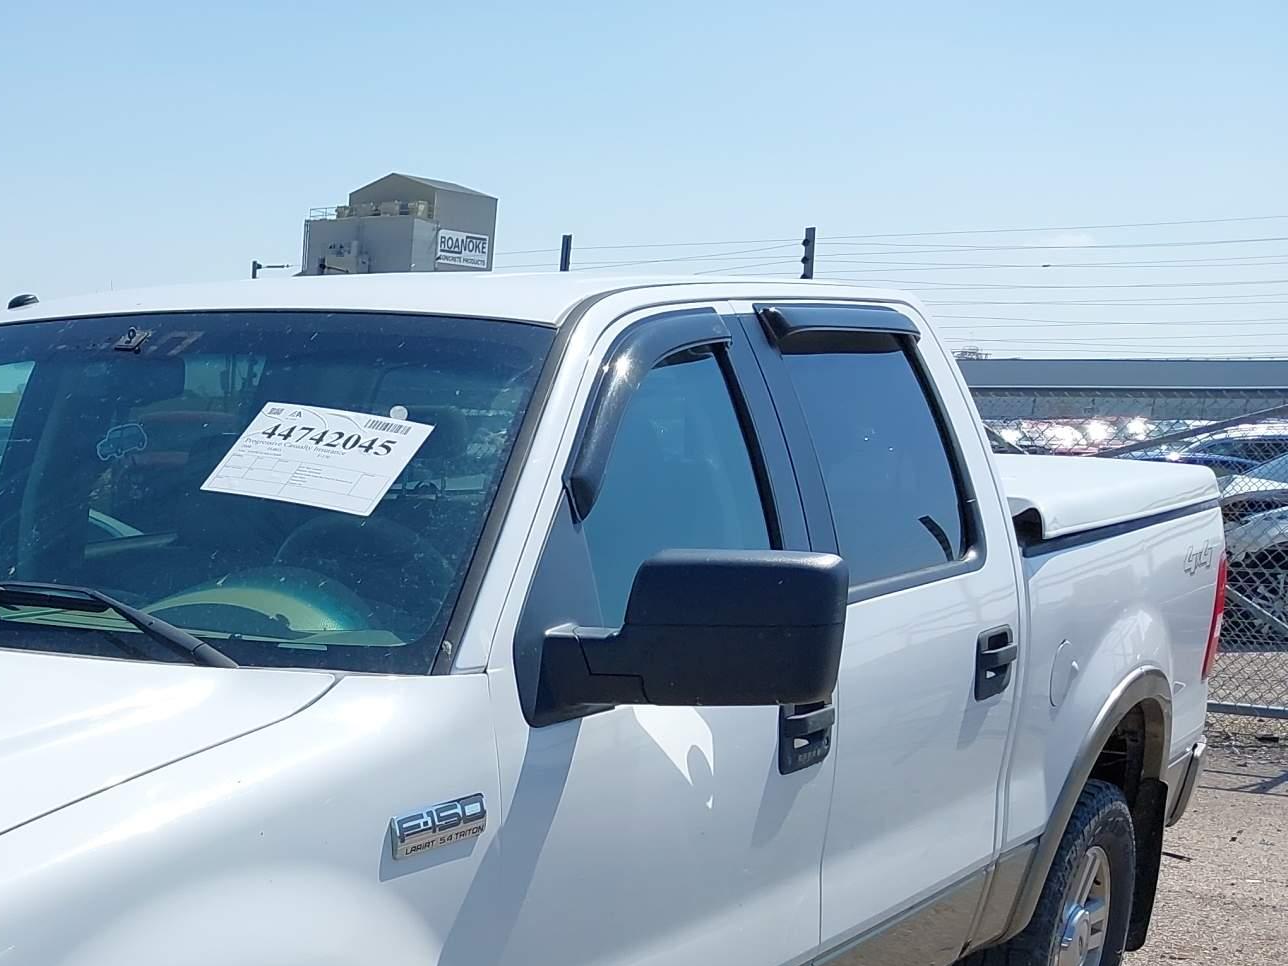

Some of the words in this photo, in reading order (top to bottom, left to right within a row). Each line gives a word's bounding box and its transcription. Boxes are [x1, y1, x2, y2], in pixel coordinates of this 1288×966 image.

[439, 235, 487, 254] ROANOKE
[463, 256, 486, 267] PRODUCTS
[262, 423, 398, 457] 44742045
[396, 794, 488, 844] F-150
[405, 839, 436, 856] LARIAT
[454, 825, 485, 840] TRITON
